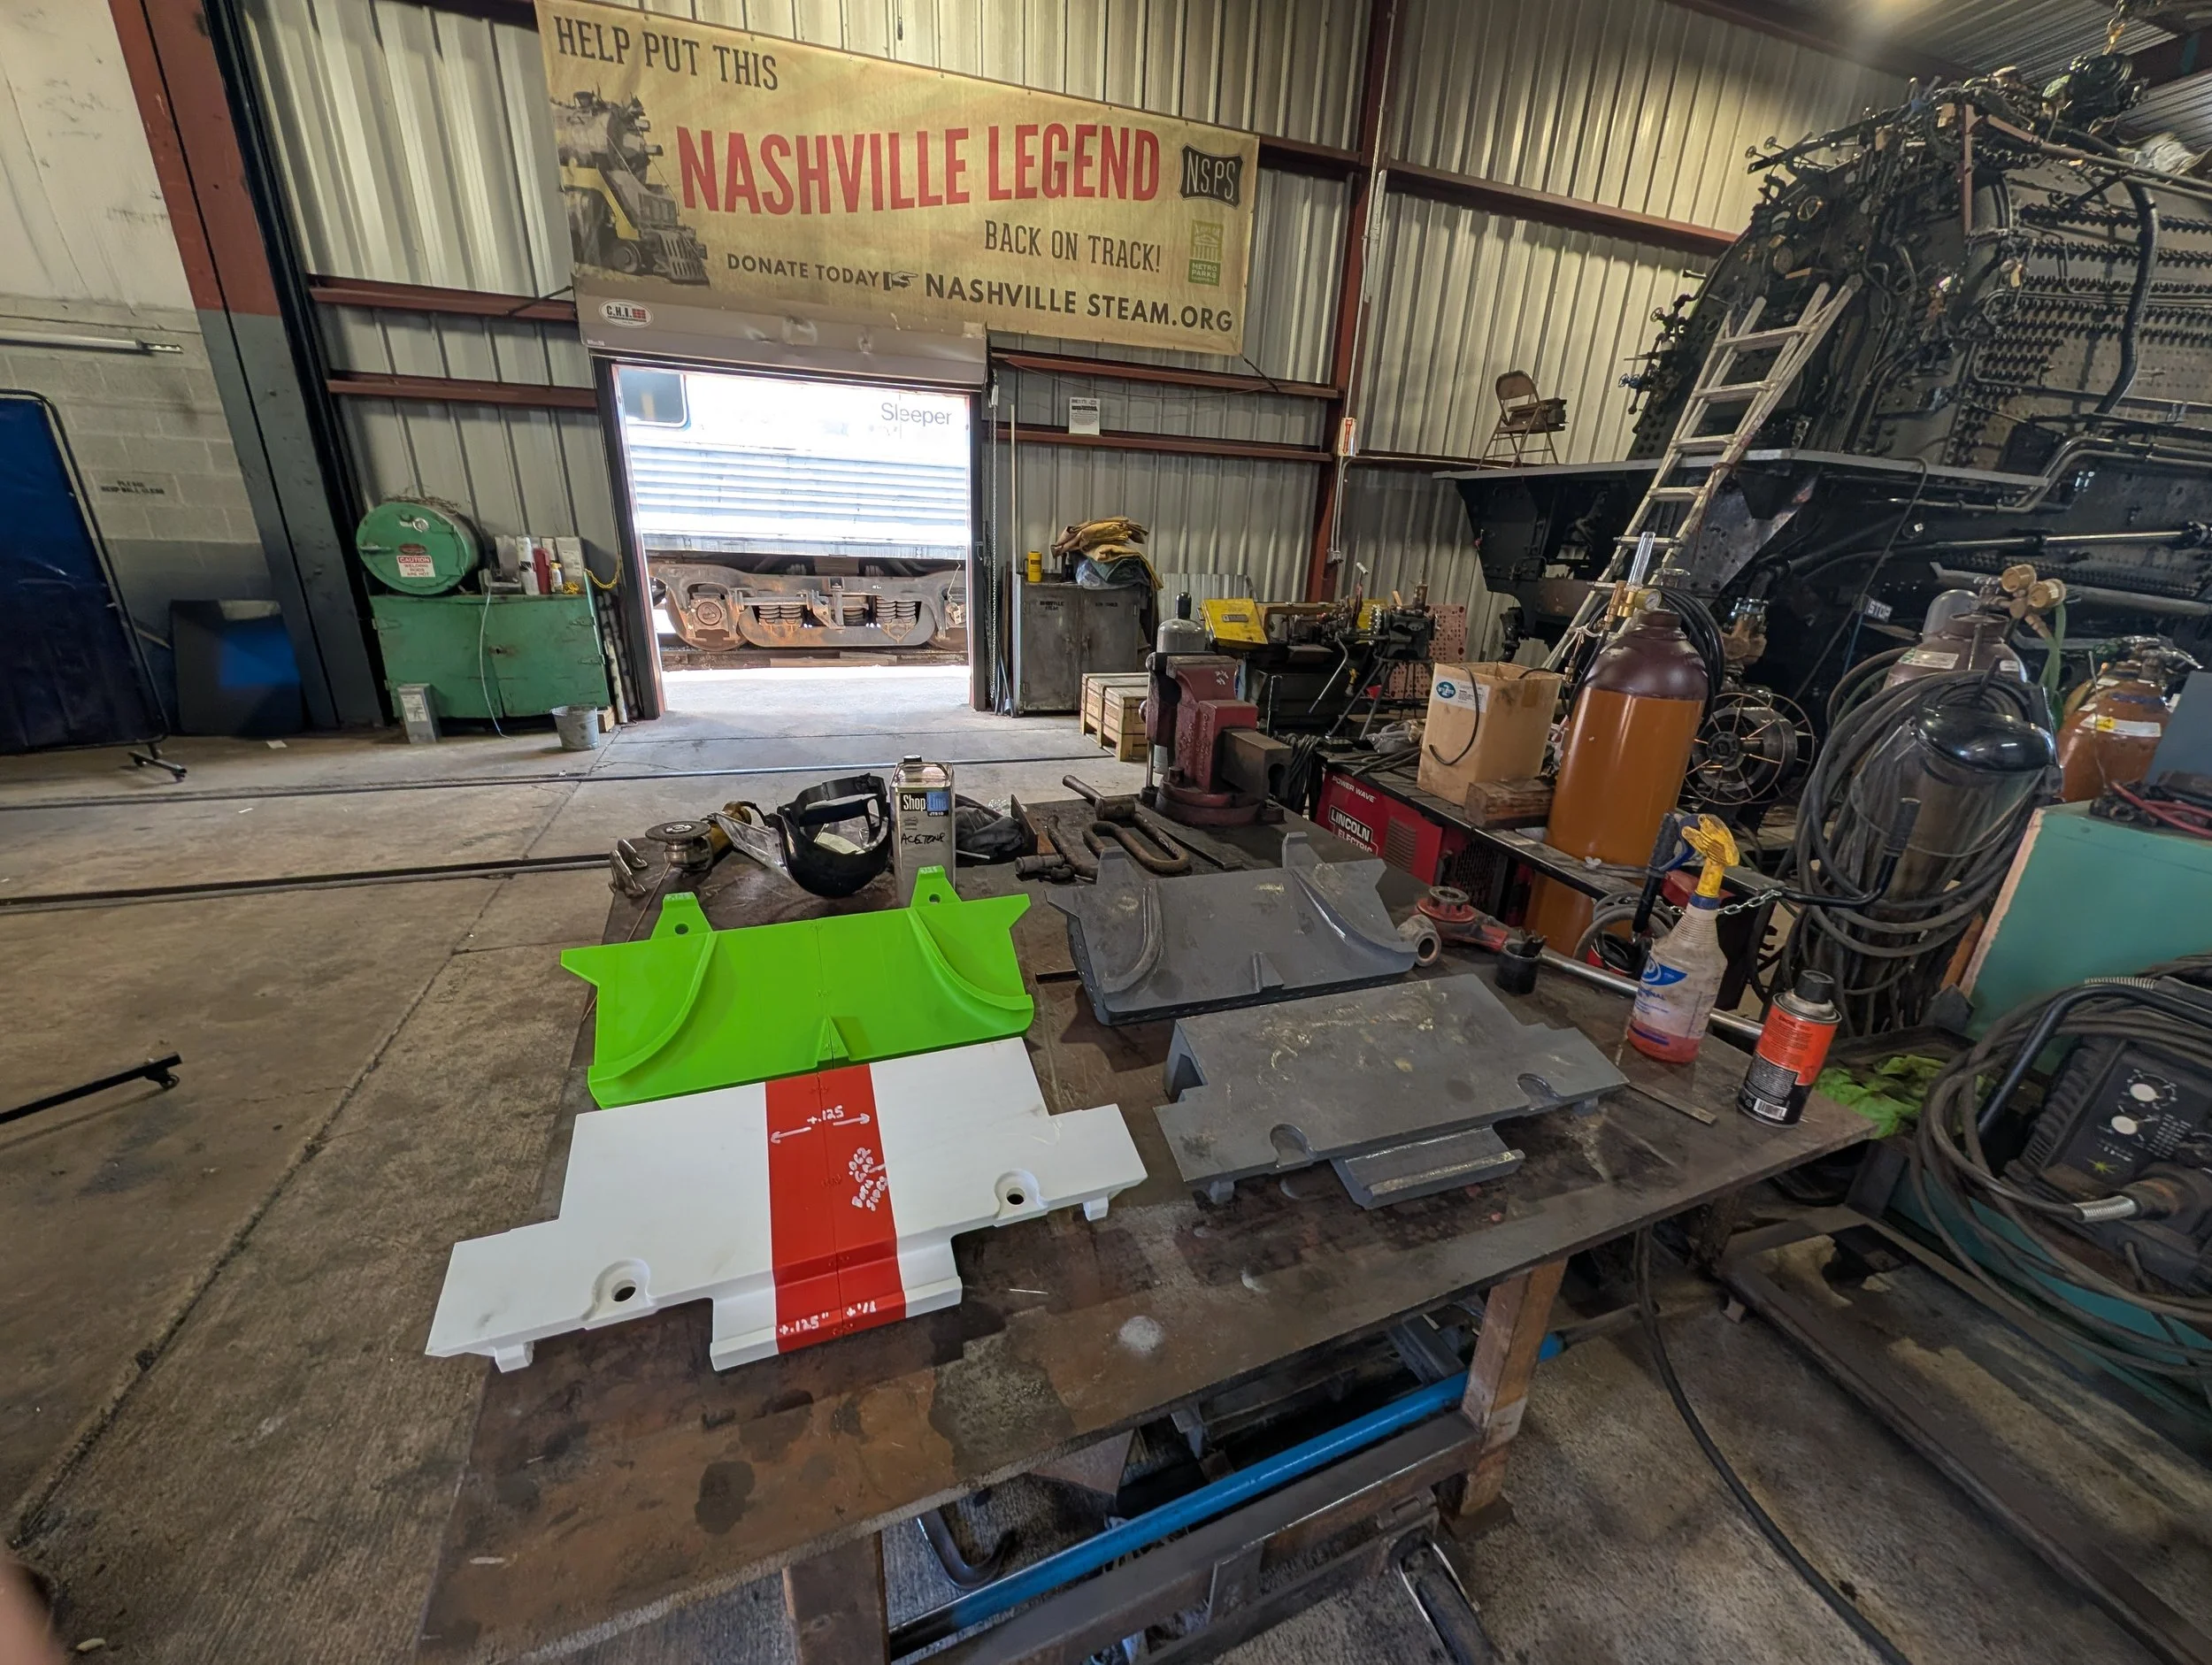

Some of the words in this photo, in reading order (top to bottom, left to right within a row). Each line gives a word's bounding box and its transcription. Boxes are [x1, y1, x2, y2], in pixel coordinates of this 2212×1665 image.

[553, 15, 630, 65] HELP
[642, 32, 700, 76] PUT
[713, 45, 779, 91] THIS
[676, 126, 970, 216] NASHVILLE
[988, 122, 1161, 202] LEGEND
[985, 219, 1041, 257] BACK
[1051, 229, 1078, 261] ON
[1087, 234, 1161, 272] TRACK!
[726, 253, 809, 279] DONATE
[814, 265, 879, 289] TODAY
[1191, 269, 1217, 279] PARKS
[1192, 263, 1217, 272] METRO
[926, 273, 1076, 314] NASHVILLE
[1087, 293, 1233, 333] STEAM.ORG
[881, 403, 952, 426] Sleeper
[1868, 600, 1892, 620] STOP
[902, 794, 926, 811] Shop
[1332, 775, 1355, 792] POWER
[1356, 787, 1375, 803] WAVE
[901, 832, 946, 845] ACETONE
[1331, 809, 1371, 842] LINCOLN
